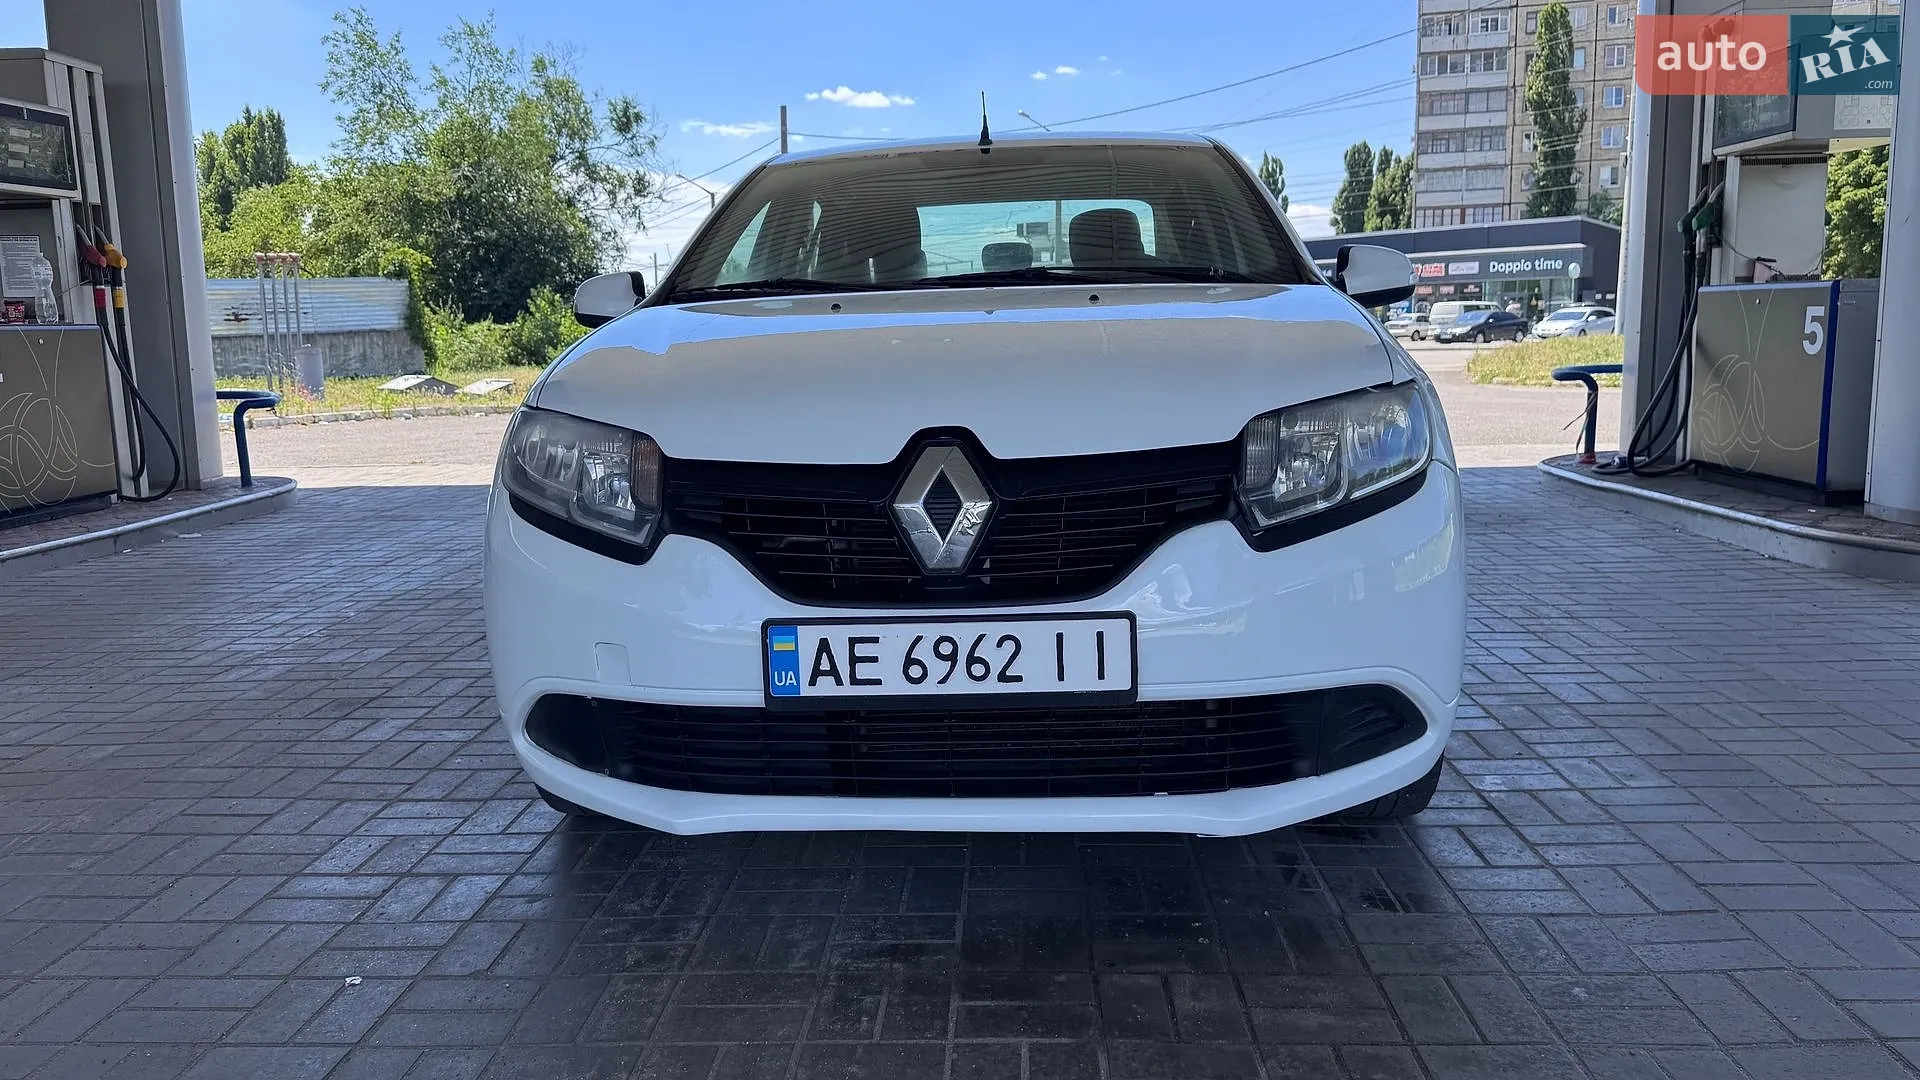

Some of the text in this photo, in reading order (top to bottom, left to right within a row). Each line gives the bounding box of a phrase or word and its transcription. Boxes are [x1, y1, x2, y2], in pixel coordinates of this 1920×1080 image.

[1489, 259, 1532, 274] Doppio
[1534, 257, 1563, 271] time
[1802, 305, 1825, 355] 5
[808, 636, 883, 687] AE
[902, 633, 1024, 686] 6962
[774, 670, 798, 687] UA
